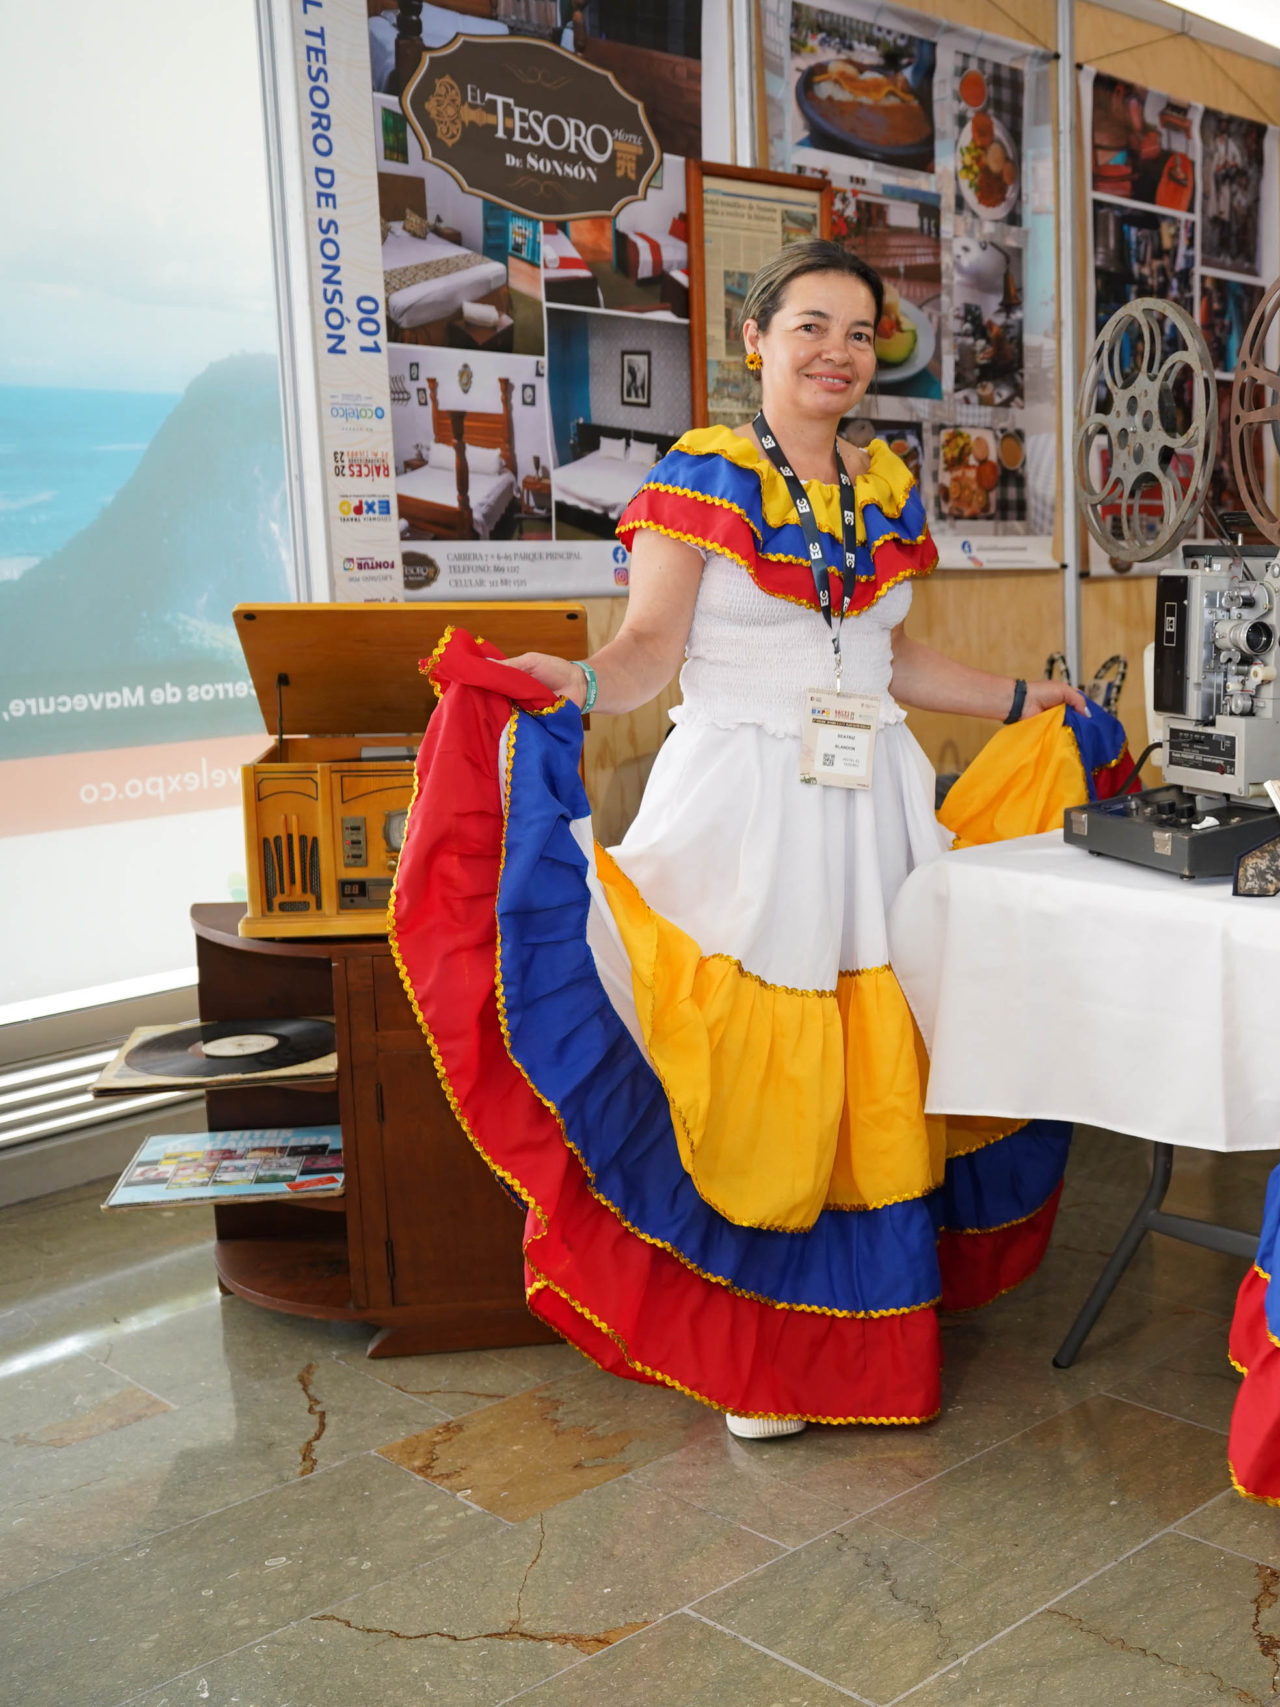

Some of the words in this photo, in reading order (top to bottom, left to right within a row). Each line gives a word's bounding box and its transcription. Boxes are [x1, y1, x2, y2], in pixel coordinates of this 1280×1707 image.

[304, 26, 334, 157] TESORO
[467, 83, 486, 105] EL
[485, 92, 613, 163] TESORO
[526, 151, 598, 183] SONSÓN
[314, 166, 337, 210] DE
[318, 216, 351, 355] SONSÓN
[355, 295, 382, 354] 001
[330, 406, 373, 422] cotelco
[333, 450, 345, 463] 23
[334, 464, 346, 477] 20
[348, 463, 390, 481] RAÍCES
[339, 499, 390, 515] EXPO
[796, 498, 810, 513] EC
[844, 510, 854, 526] EC
[446, 552, 483, 561] CARRERA
[513, 551, 542, 562] PARQUE
[545, 551, 582, 560] PRINCIPAL
[809, 542, 822, 559] EC
[357, 560, 395, 570] FONTUR
[846, 552, 855, 569] EC
[820, 590, 829, 606] EC
